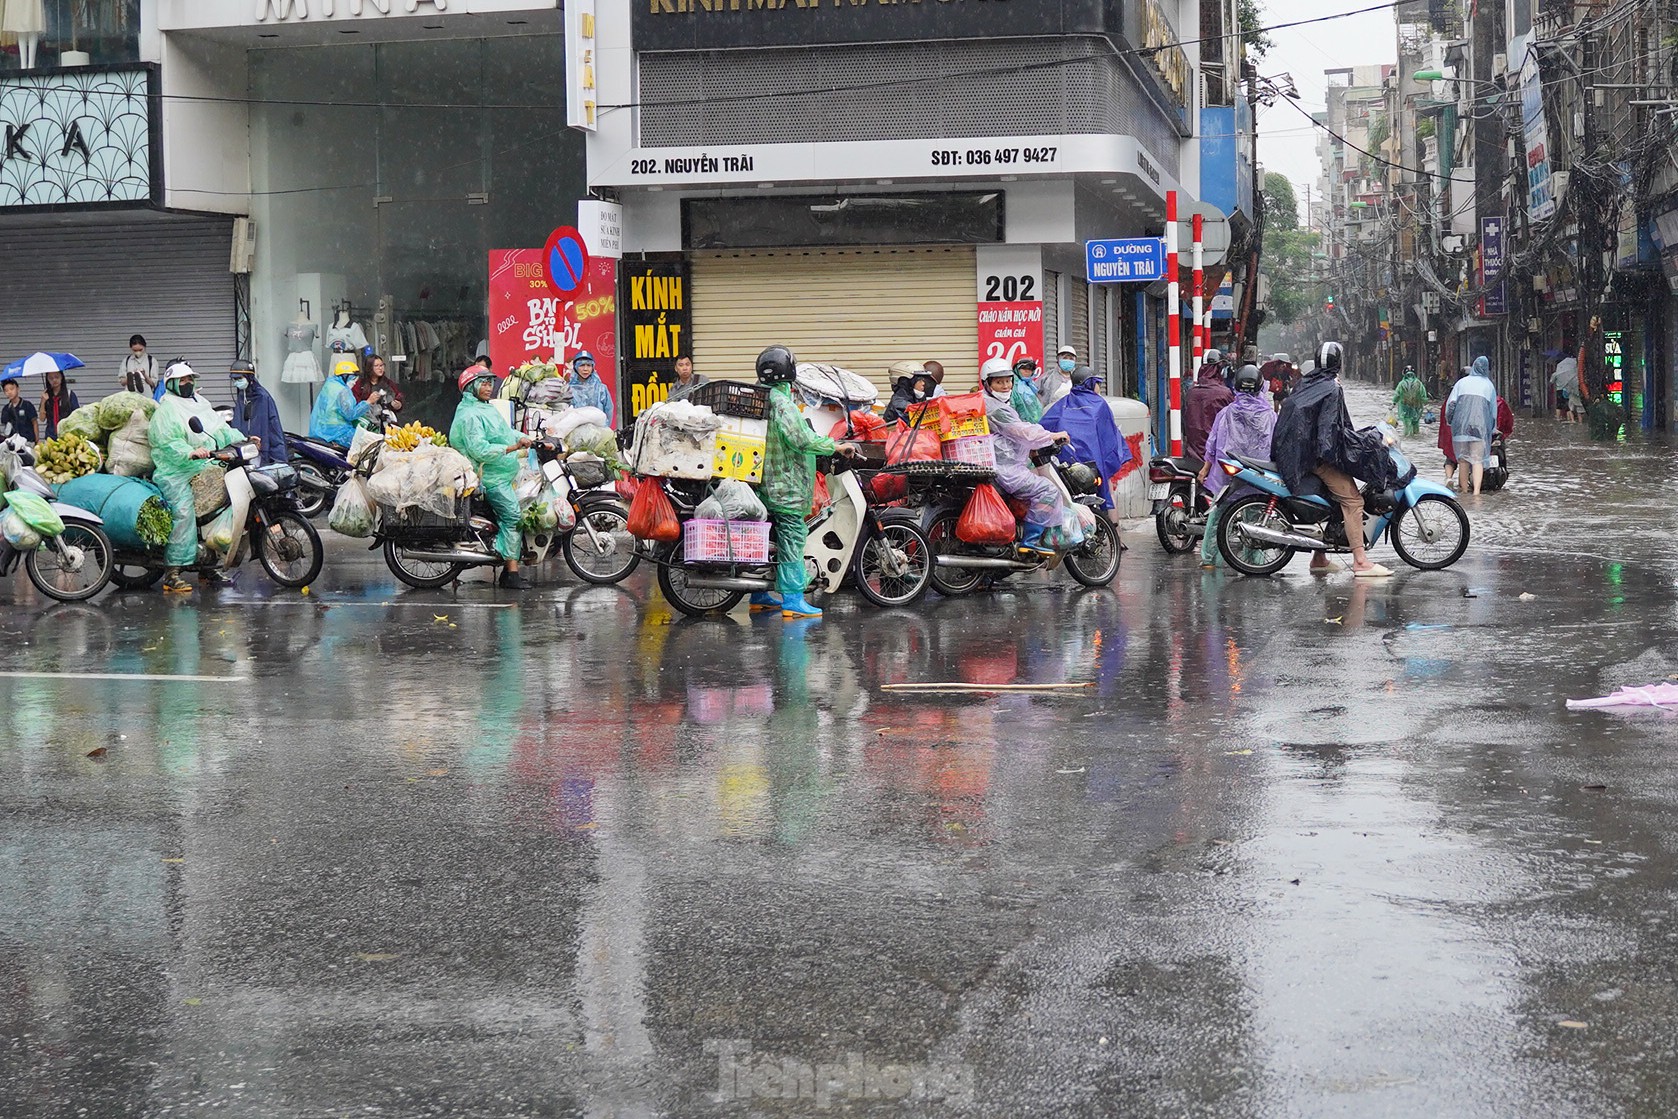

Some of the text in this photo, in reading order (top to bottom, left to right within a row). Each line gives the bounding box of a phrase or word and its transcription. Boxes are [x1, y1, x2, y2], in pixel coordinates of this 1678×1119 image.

[631, 153, 754, 174] 202. NGUYỄN TRÃI
[931, 147, 1057, 165] SĐT: 036 497 9427
[1113, 243, 1153, 255] ĐƯỜNG
[514, 262, 543, 278] BIG
[1093, 257, 1155, 277] NGUYỄN TRÃI
[631, 269, 682, 310] KÍNH
[985, 275, 1035, 302] 202
[575, 295, 615, 320] 50%
[1013, 308, 1028, 326] HỌC
[634, 311, 681, 358] MẮT
